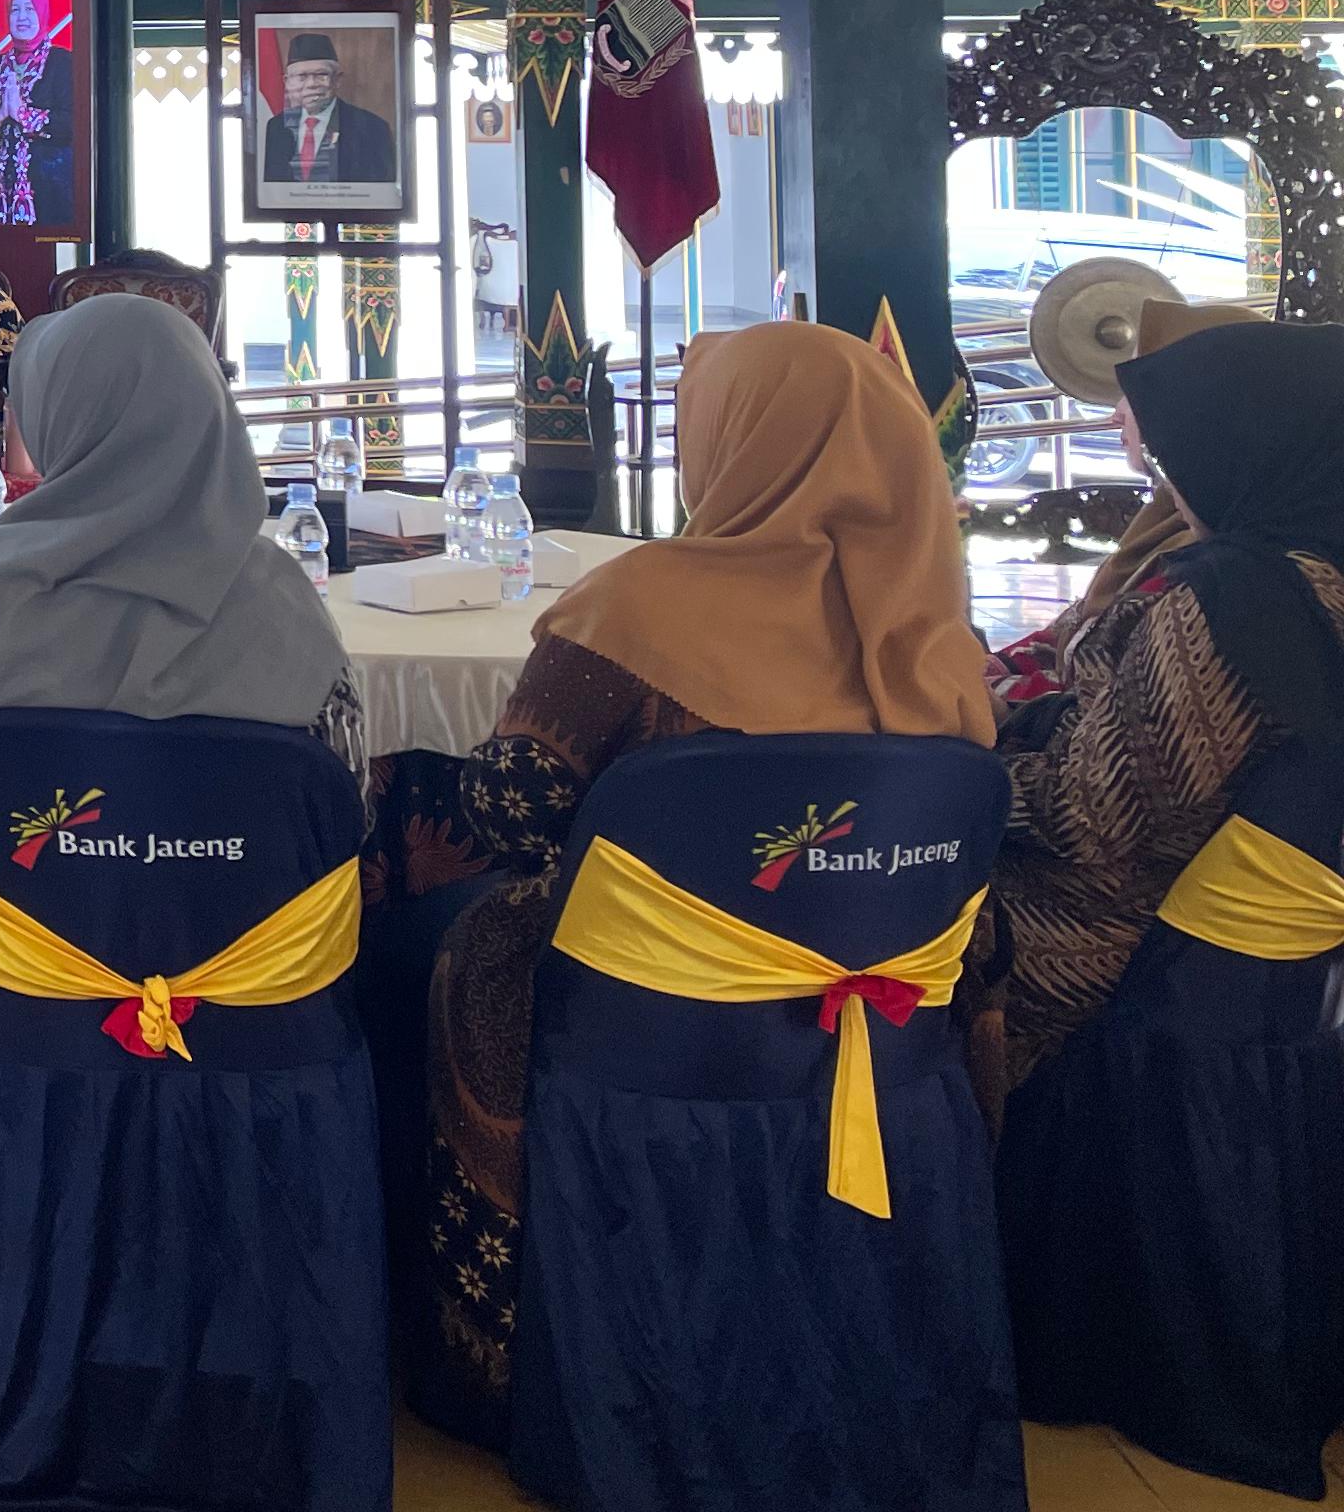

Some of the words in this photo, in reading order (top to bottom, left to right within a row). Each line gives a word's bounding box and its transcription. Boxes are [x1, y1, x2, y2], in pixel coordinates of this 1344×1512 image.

[57, 830, 137, 857] Bank
[143, 833, 245, 864] Jateng
[807, 847, 882, 872] Bank
[887, 840, 961, 876] Jateng
